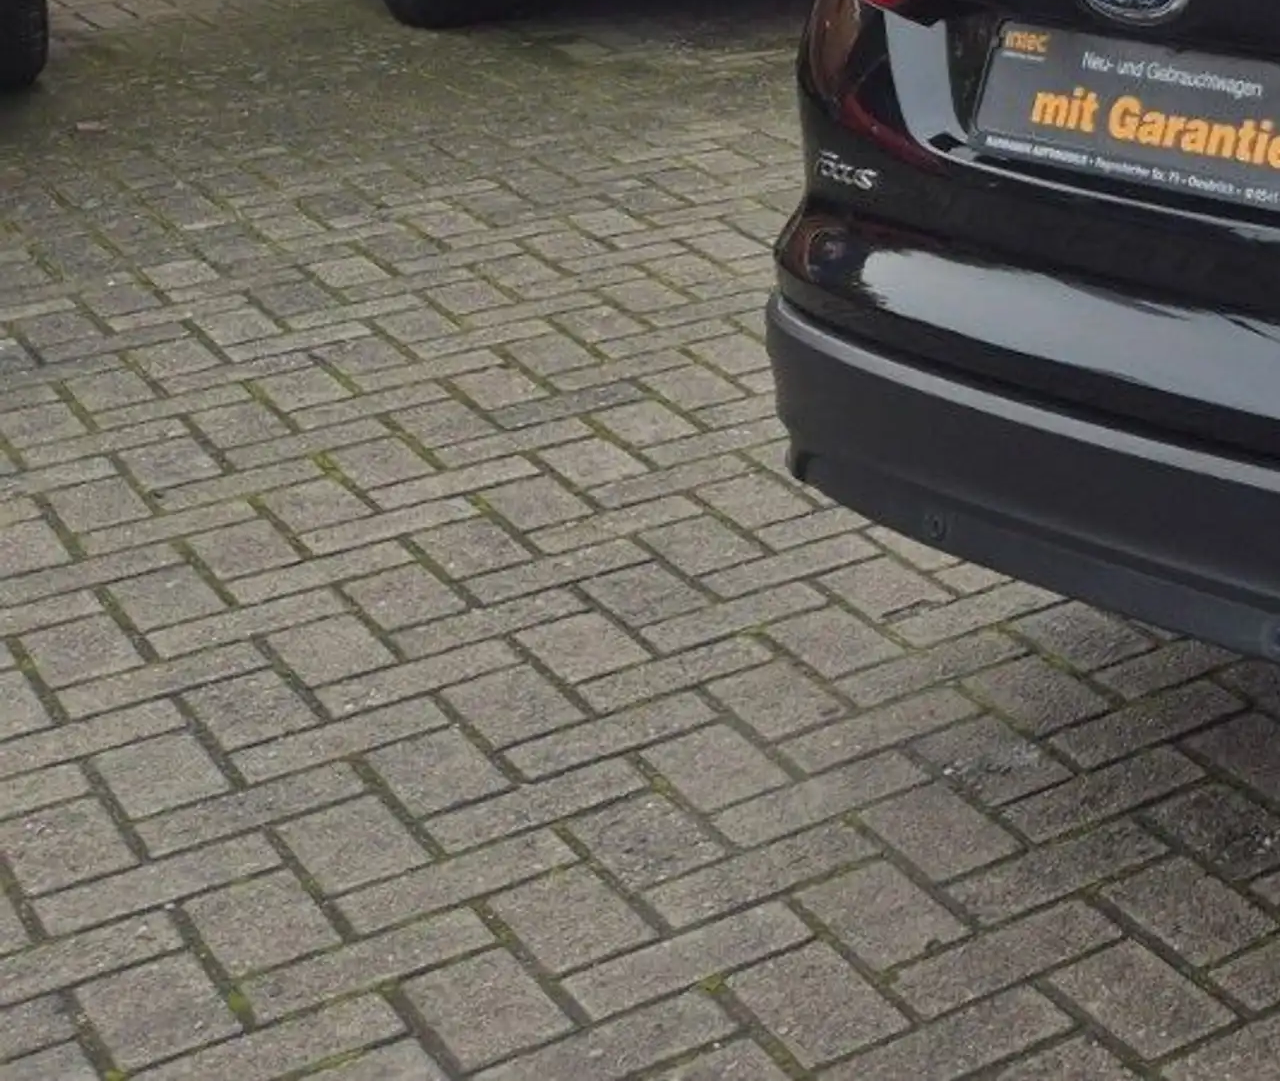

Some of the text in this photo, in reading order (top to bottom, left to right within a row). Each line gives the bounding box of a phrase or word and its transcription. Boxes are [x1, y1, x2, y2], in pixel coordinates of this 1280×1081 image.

[1116, 58, 1144, 77] und
[1147, 62, 1263, 100] Gebrauchtwagen
[1031, 86, 1099, 133] mit
